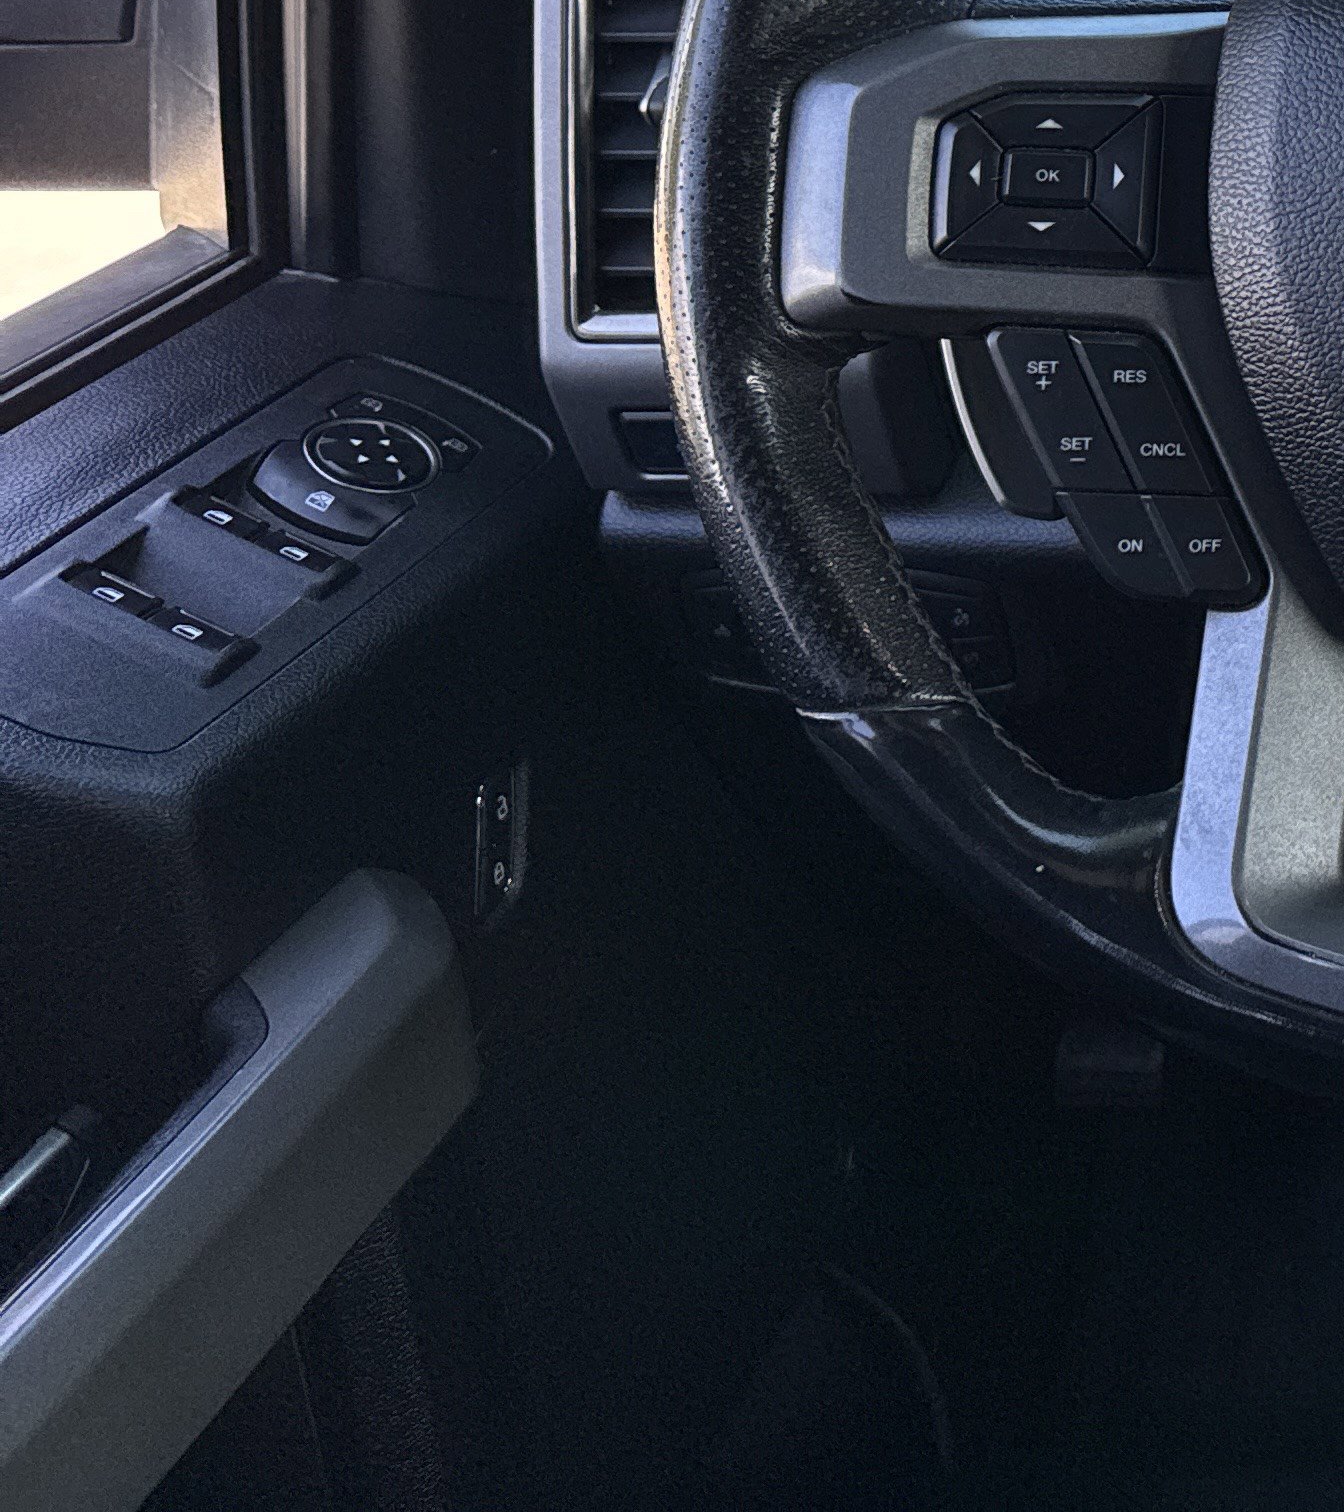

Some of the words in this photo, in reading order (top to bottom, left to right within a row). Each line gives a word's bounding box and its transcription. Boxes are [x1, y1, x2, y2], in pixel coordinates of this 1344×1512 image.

[1035, 168, 1061, 182] OK
[1026, 360, 1059, 375] SET
[1112, 370, 1147, 384] RES
[1060, 436, 1093, 451] SET
[1139, 442, 1186, 457] CNCL
[1117, 539, 1143, 553] ON
[1188, 538, 1222, 553] OFF
